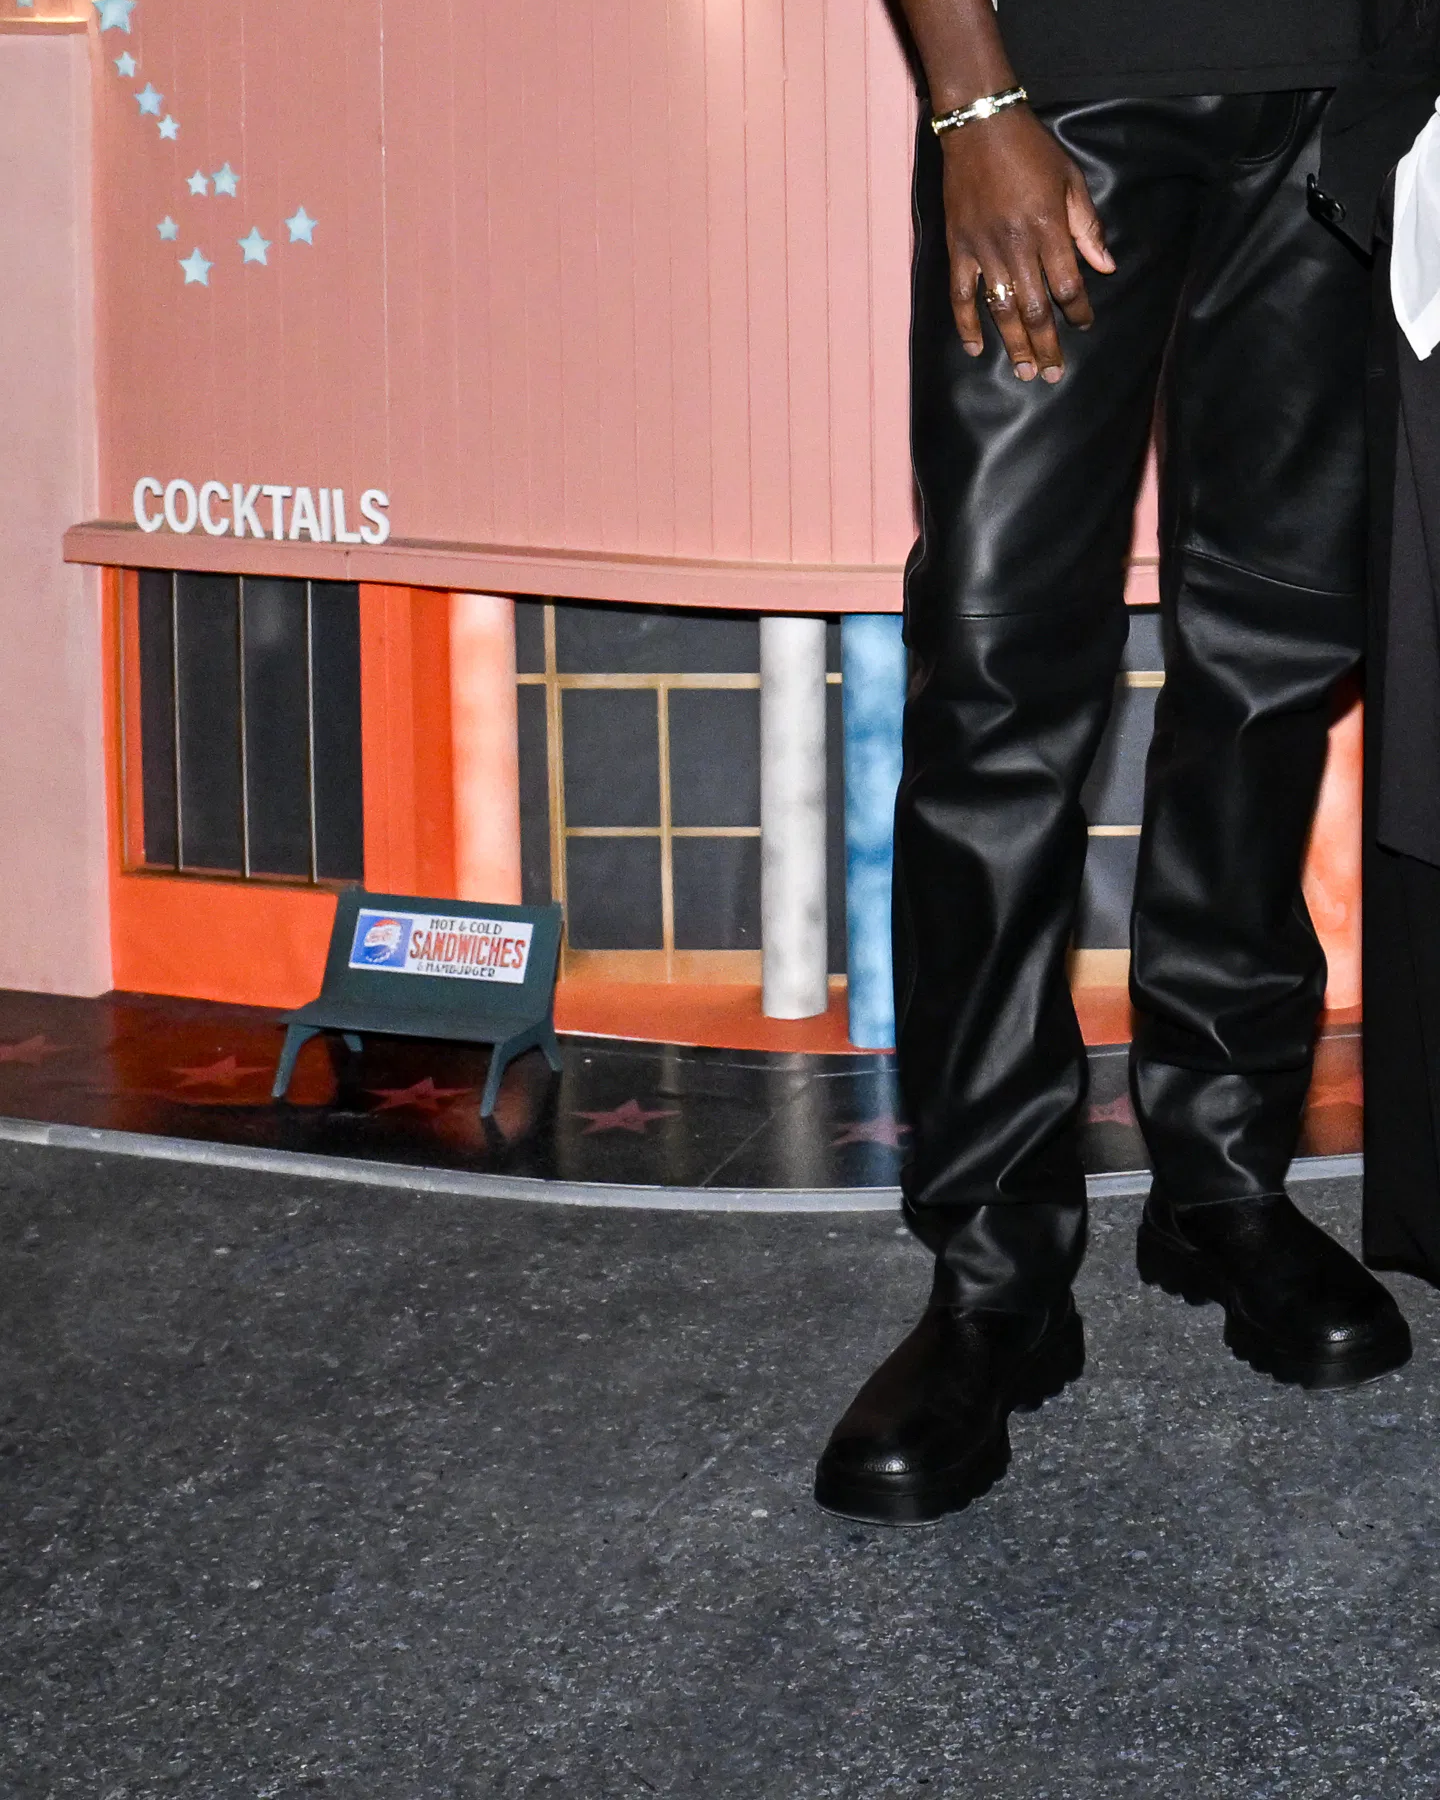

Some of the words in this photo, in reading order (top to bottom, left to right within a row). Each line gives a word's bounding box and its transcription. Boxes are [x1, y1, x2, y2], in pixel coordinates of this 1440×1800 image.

[132, 476, 391, 545] COCKTAILS
[429, 918, 455, 932] HOT
[469, 922, 502, 936] COLD
[409, 929, 526, 970] SANDWICHES
